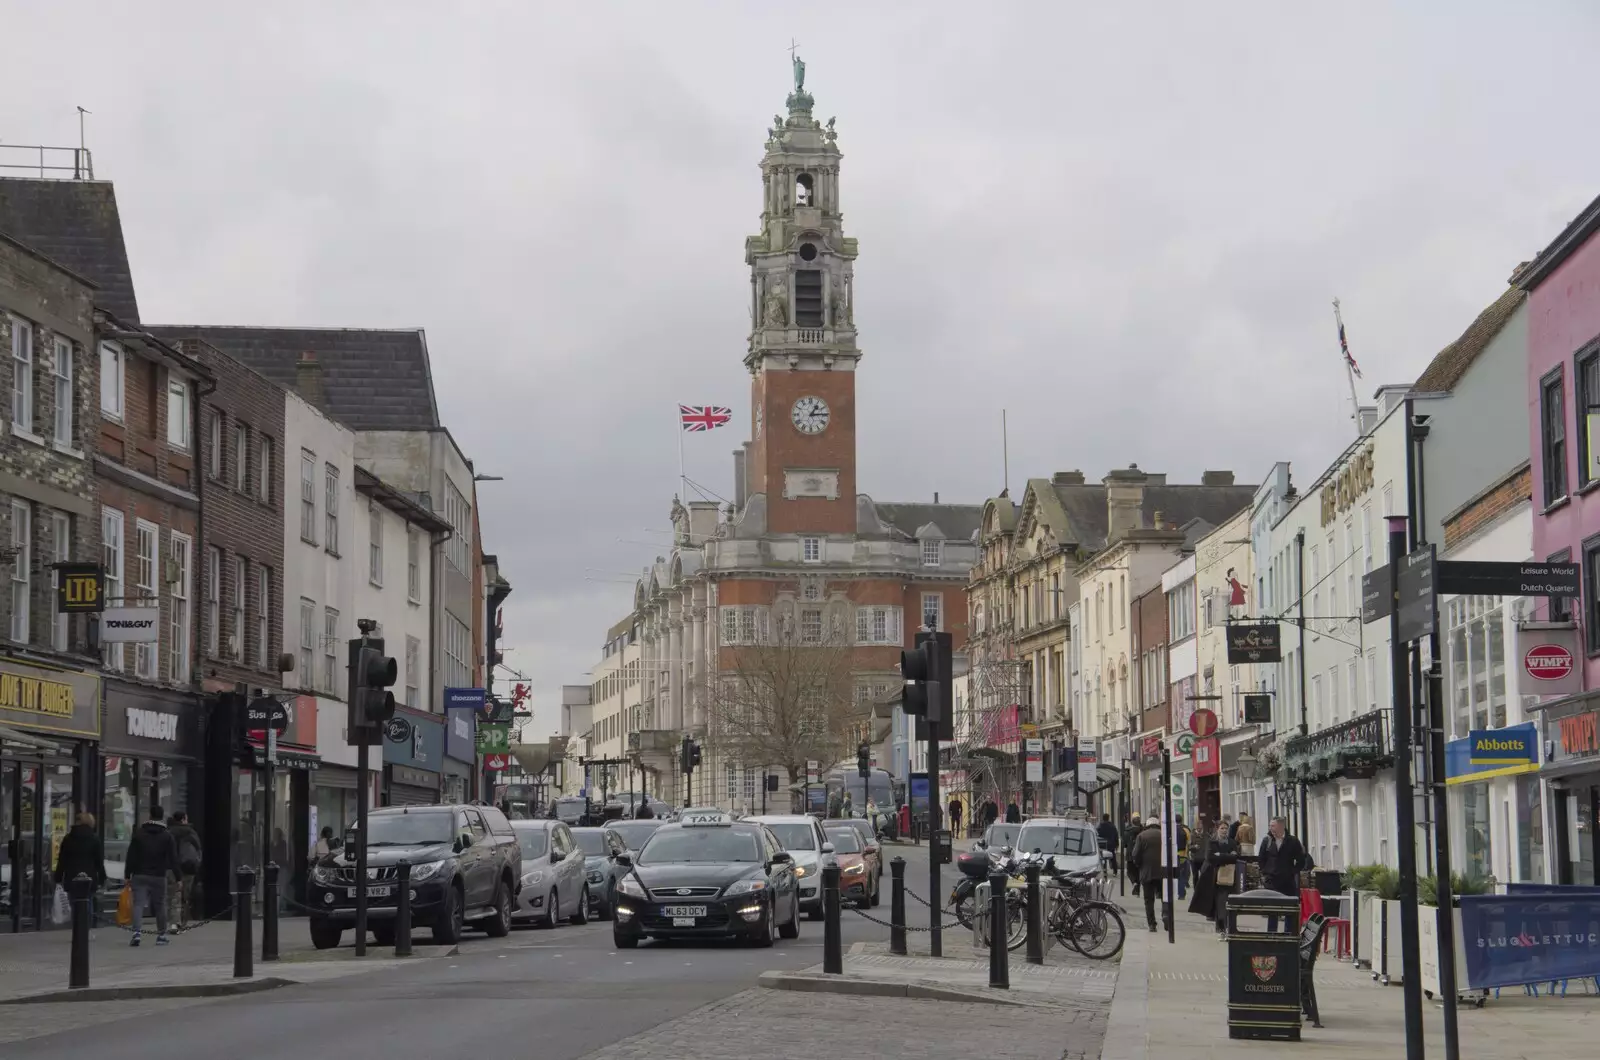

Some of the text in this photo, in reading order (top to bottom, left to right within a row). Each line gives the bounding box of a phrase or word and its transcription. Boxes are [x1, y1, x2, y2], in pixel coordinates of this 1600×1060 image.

[1520, 567, 1574, 575] Leisure World
[65, 578, 97, 602] LTB
[1520, 583, 1574, 593] Dutch Quarter
[106, 620, 153, 628] TONI&GUY
[1527, 657, 1571, 667] WIMPY
[0, 673, 73, 715] OVE THY BURGER
[451, 694, 482, 702] shoezone
[1558, 711, 1598, 753] WIMPY
[1476, 739, 1525, 750] Abbotts
[690, 815, 722, 823] TAXI
[370, 887, 386, 895] VRZ
[665, 907, 687, 916] ML63
[1477, 938, 1520, 948] SLUG
[1532, 933, 1597, 945] LETTUC
[1244, 984, 1285, 993] COLCHESTER
